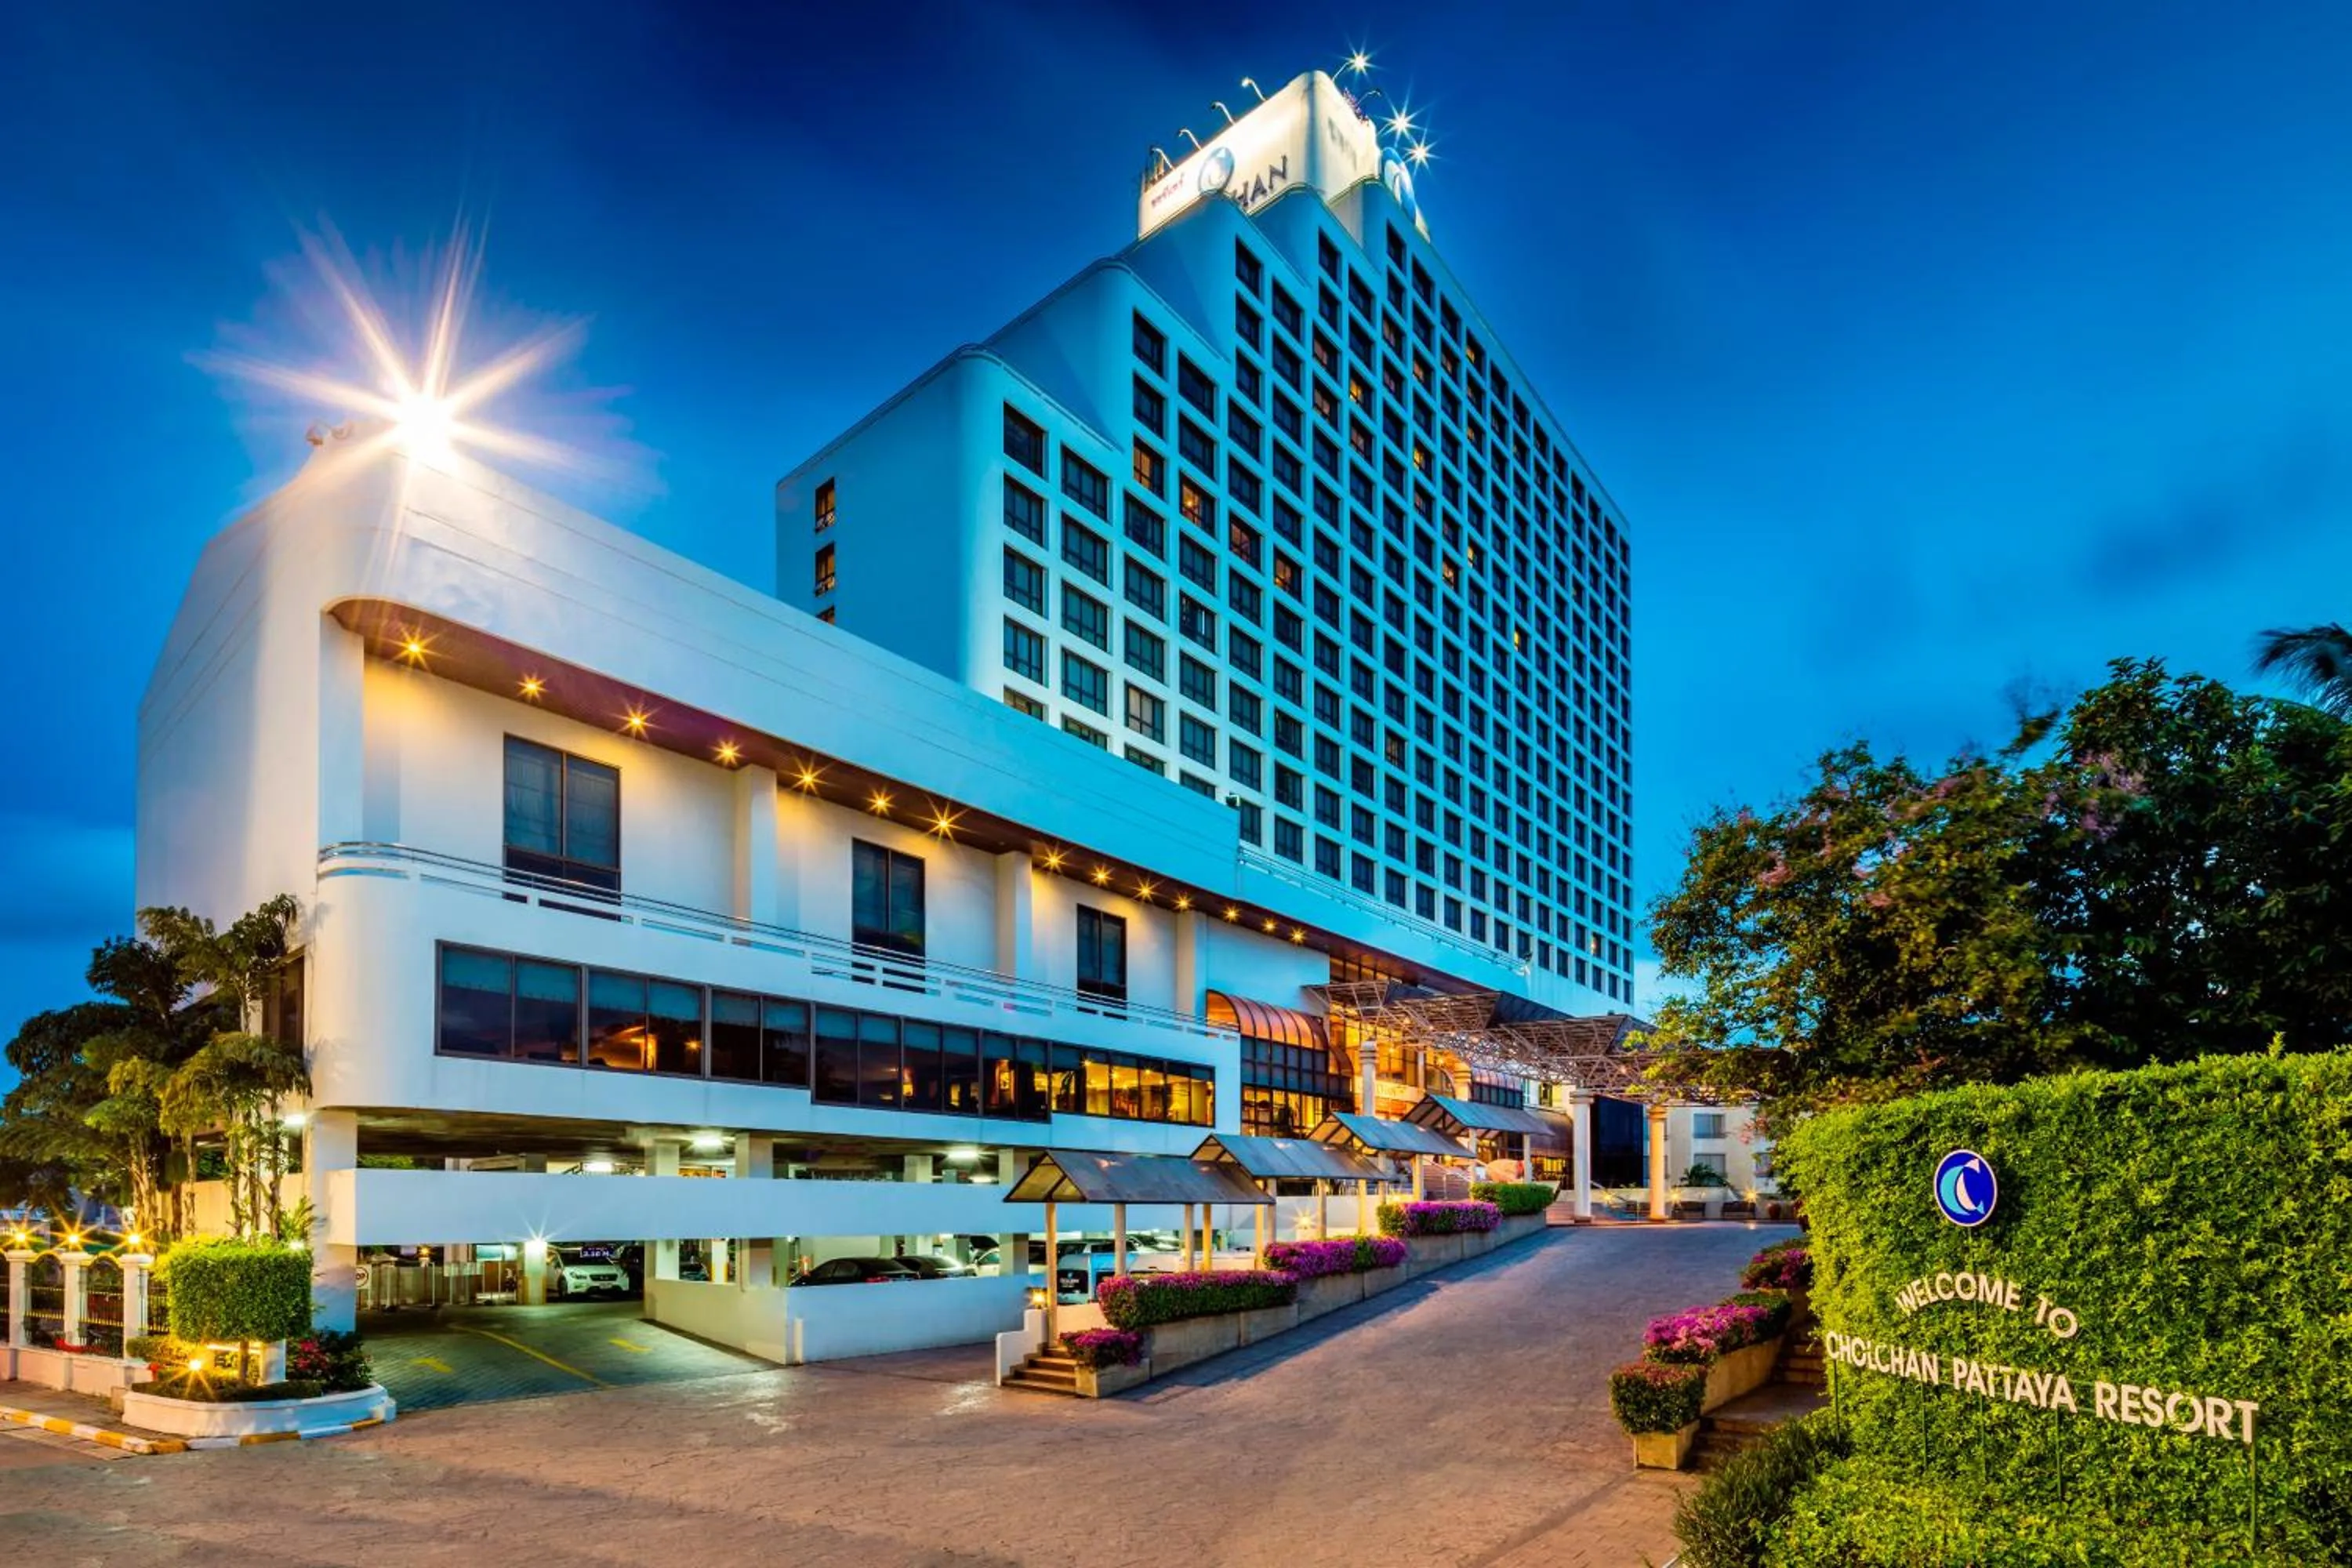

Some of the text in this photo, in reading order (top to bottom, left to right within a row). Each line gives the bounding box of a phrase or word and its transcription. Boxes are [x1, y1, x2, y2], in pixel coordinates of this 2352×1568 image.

[1894, 1272, 2078, 1339] WELCOME TO
[1825, 1330, 2259, 1444] CHOLCHAN PATTAYA RESORT
